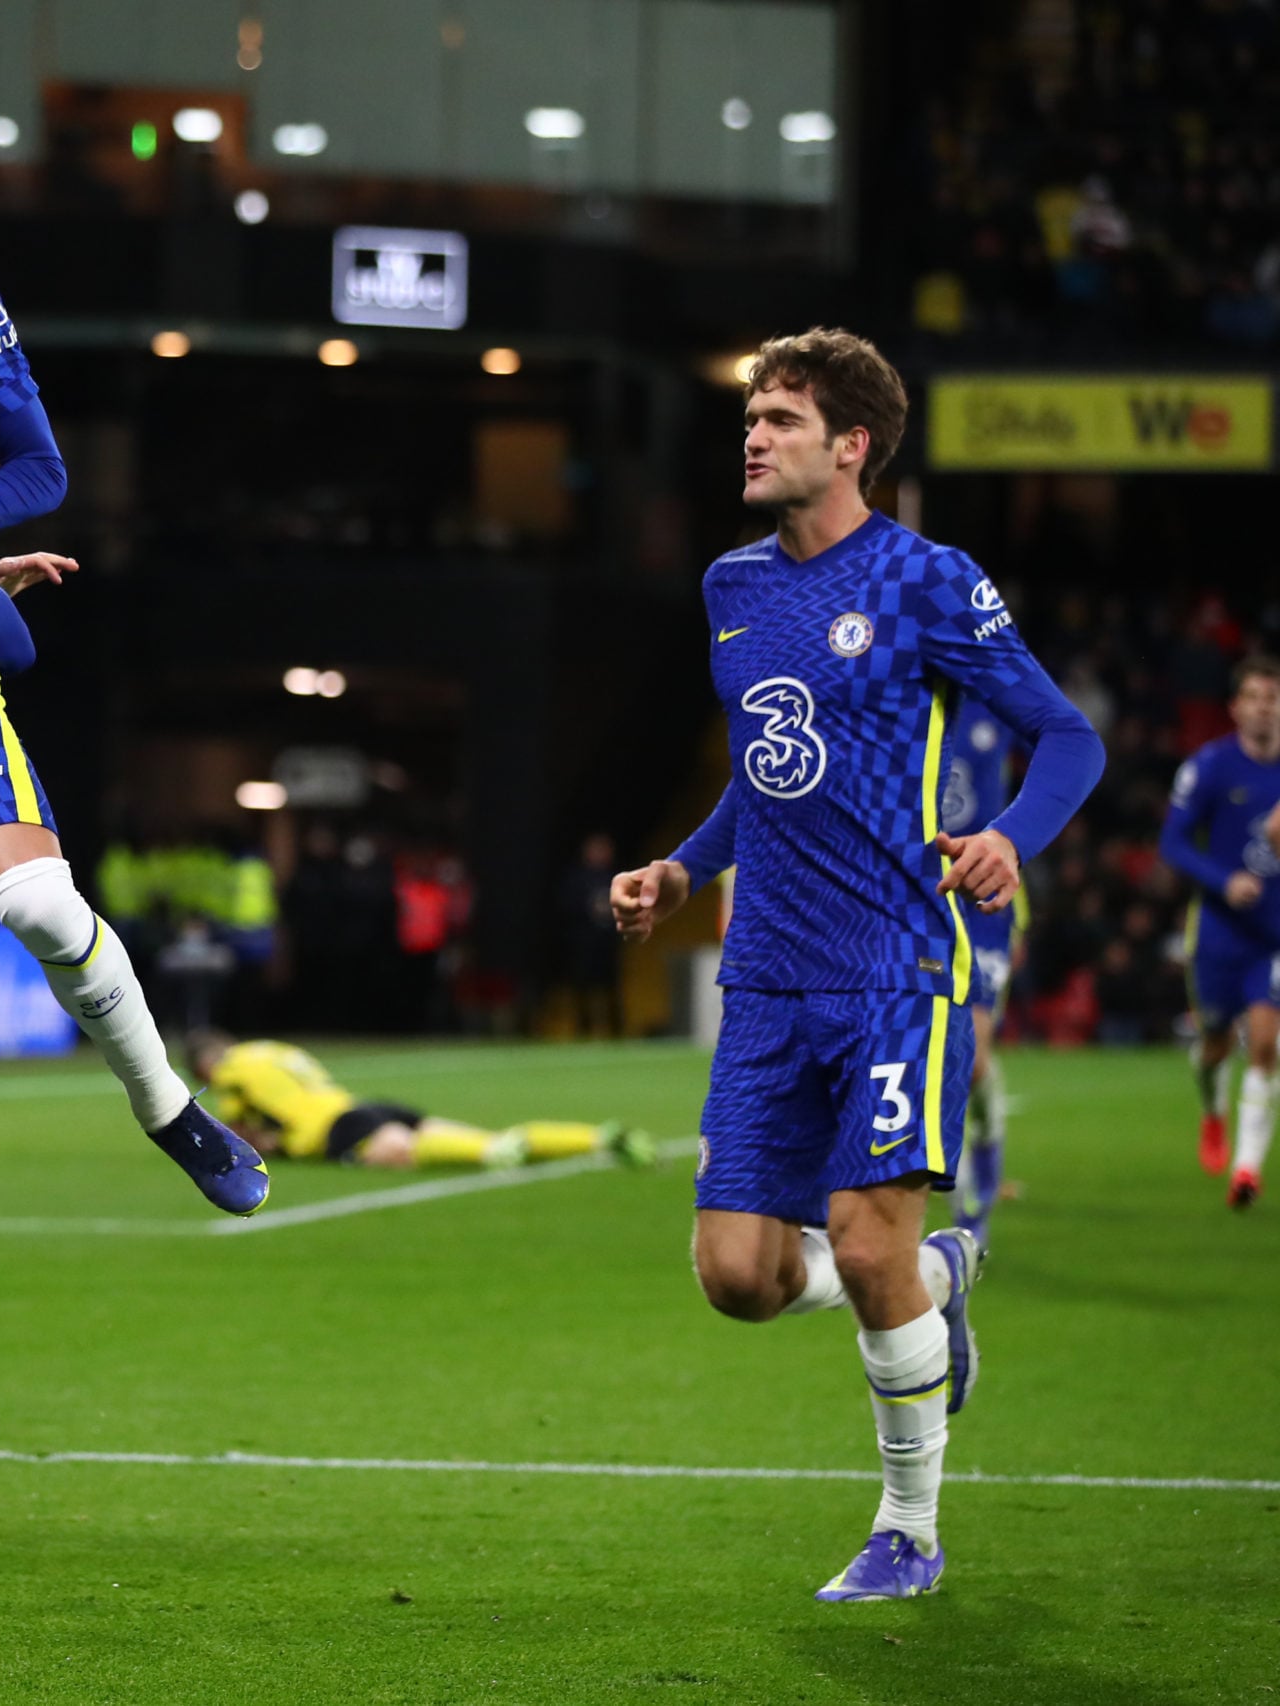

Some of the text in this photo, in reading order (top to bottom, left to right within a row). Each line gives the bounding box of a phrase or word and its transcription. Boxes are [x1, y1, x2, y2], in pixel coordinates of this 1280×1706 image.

[741, 676, 827, 800] 3
[80, 985, 122, 1012] CFC
[869, 1062, 912, 1132] 3
